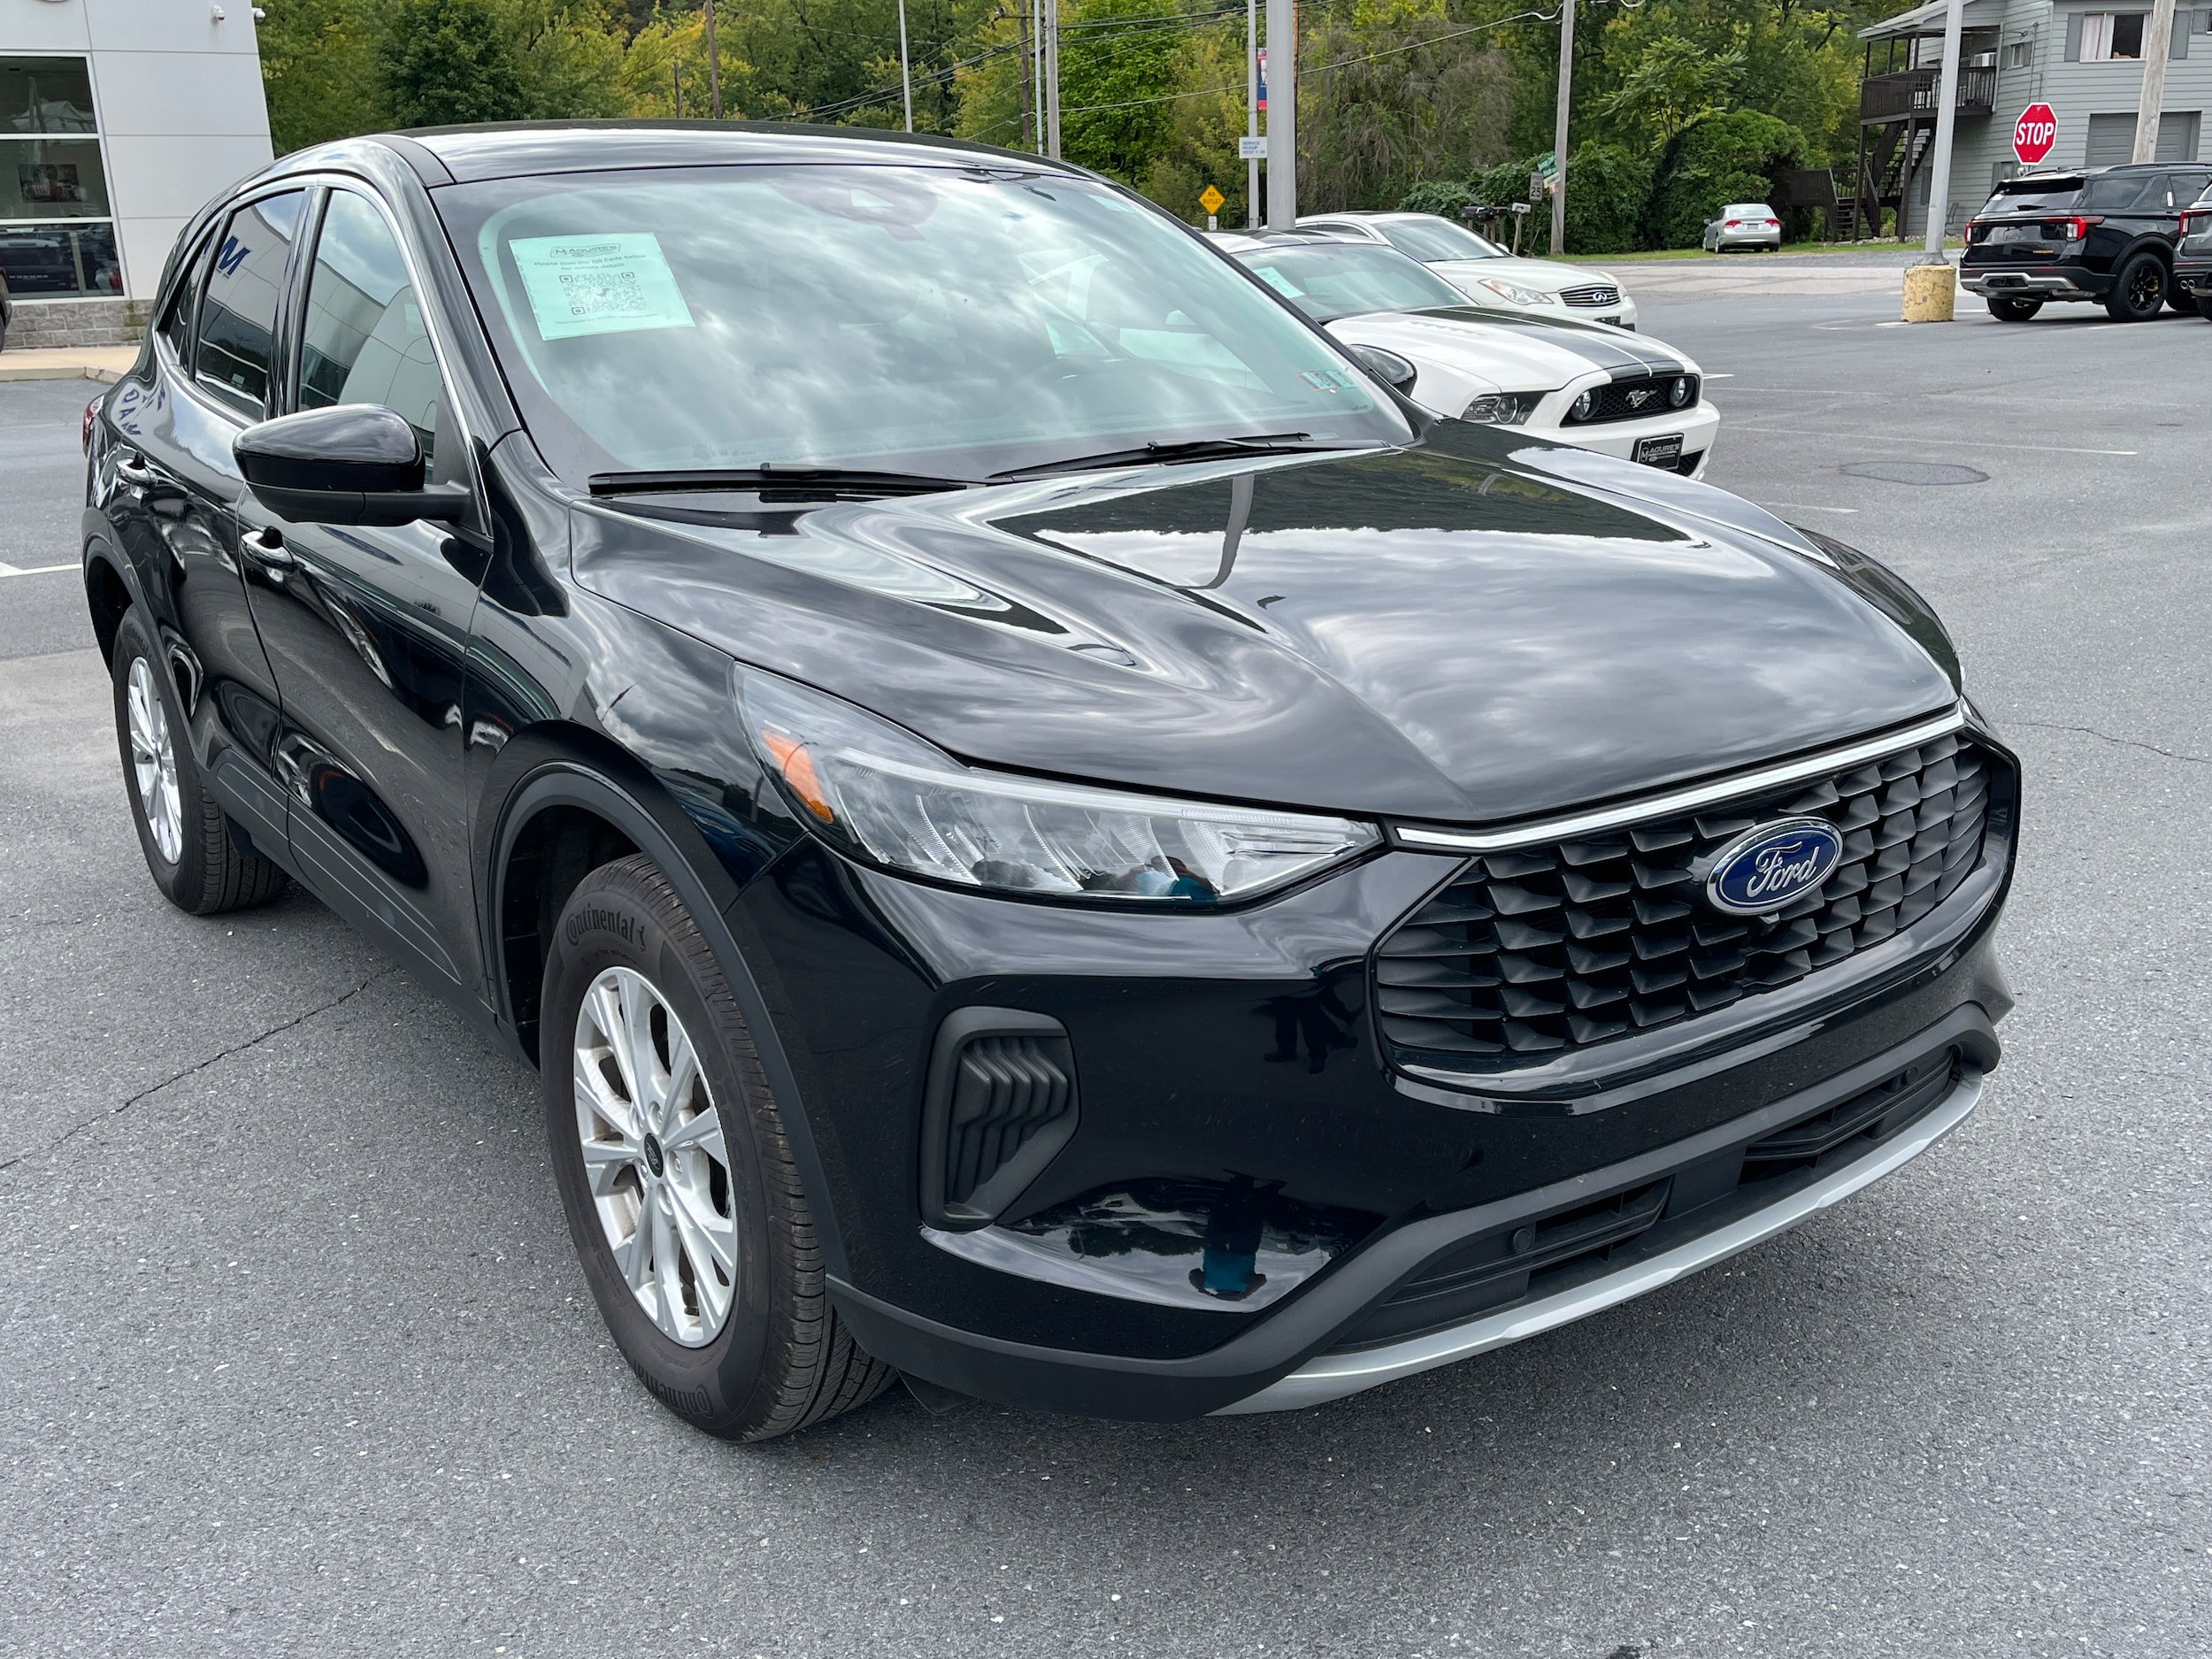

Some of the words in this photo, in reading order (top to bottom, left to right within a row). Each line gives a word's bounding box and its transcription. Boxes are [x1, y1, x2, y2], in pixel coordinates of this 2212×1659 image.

[2016, 122, 2054, 145] STOP
[1531, 187, 1541, 197] 25
[1746, 841, 1819, 898] Ford
[567, 902, 635, 947] Continental
